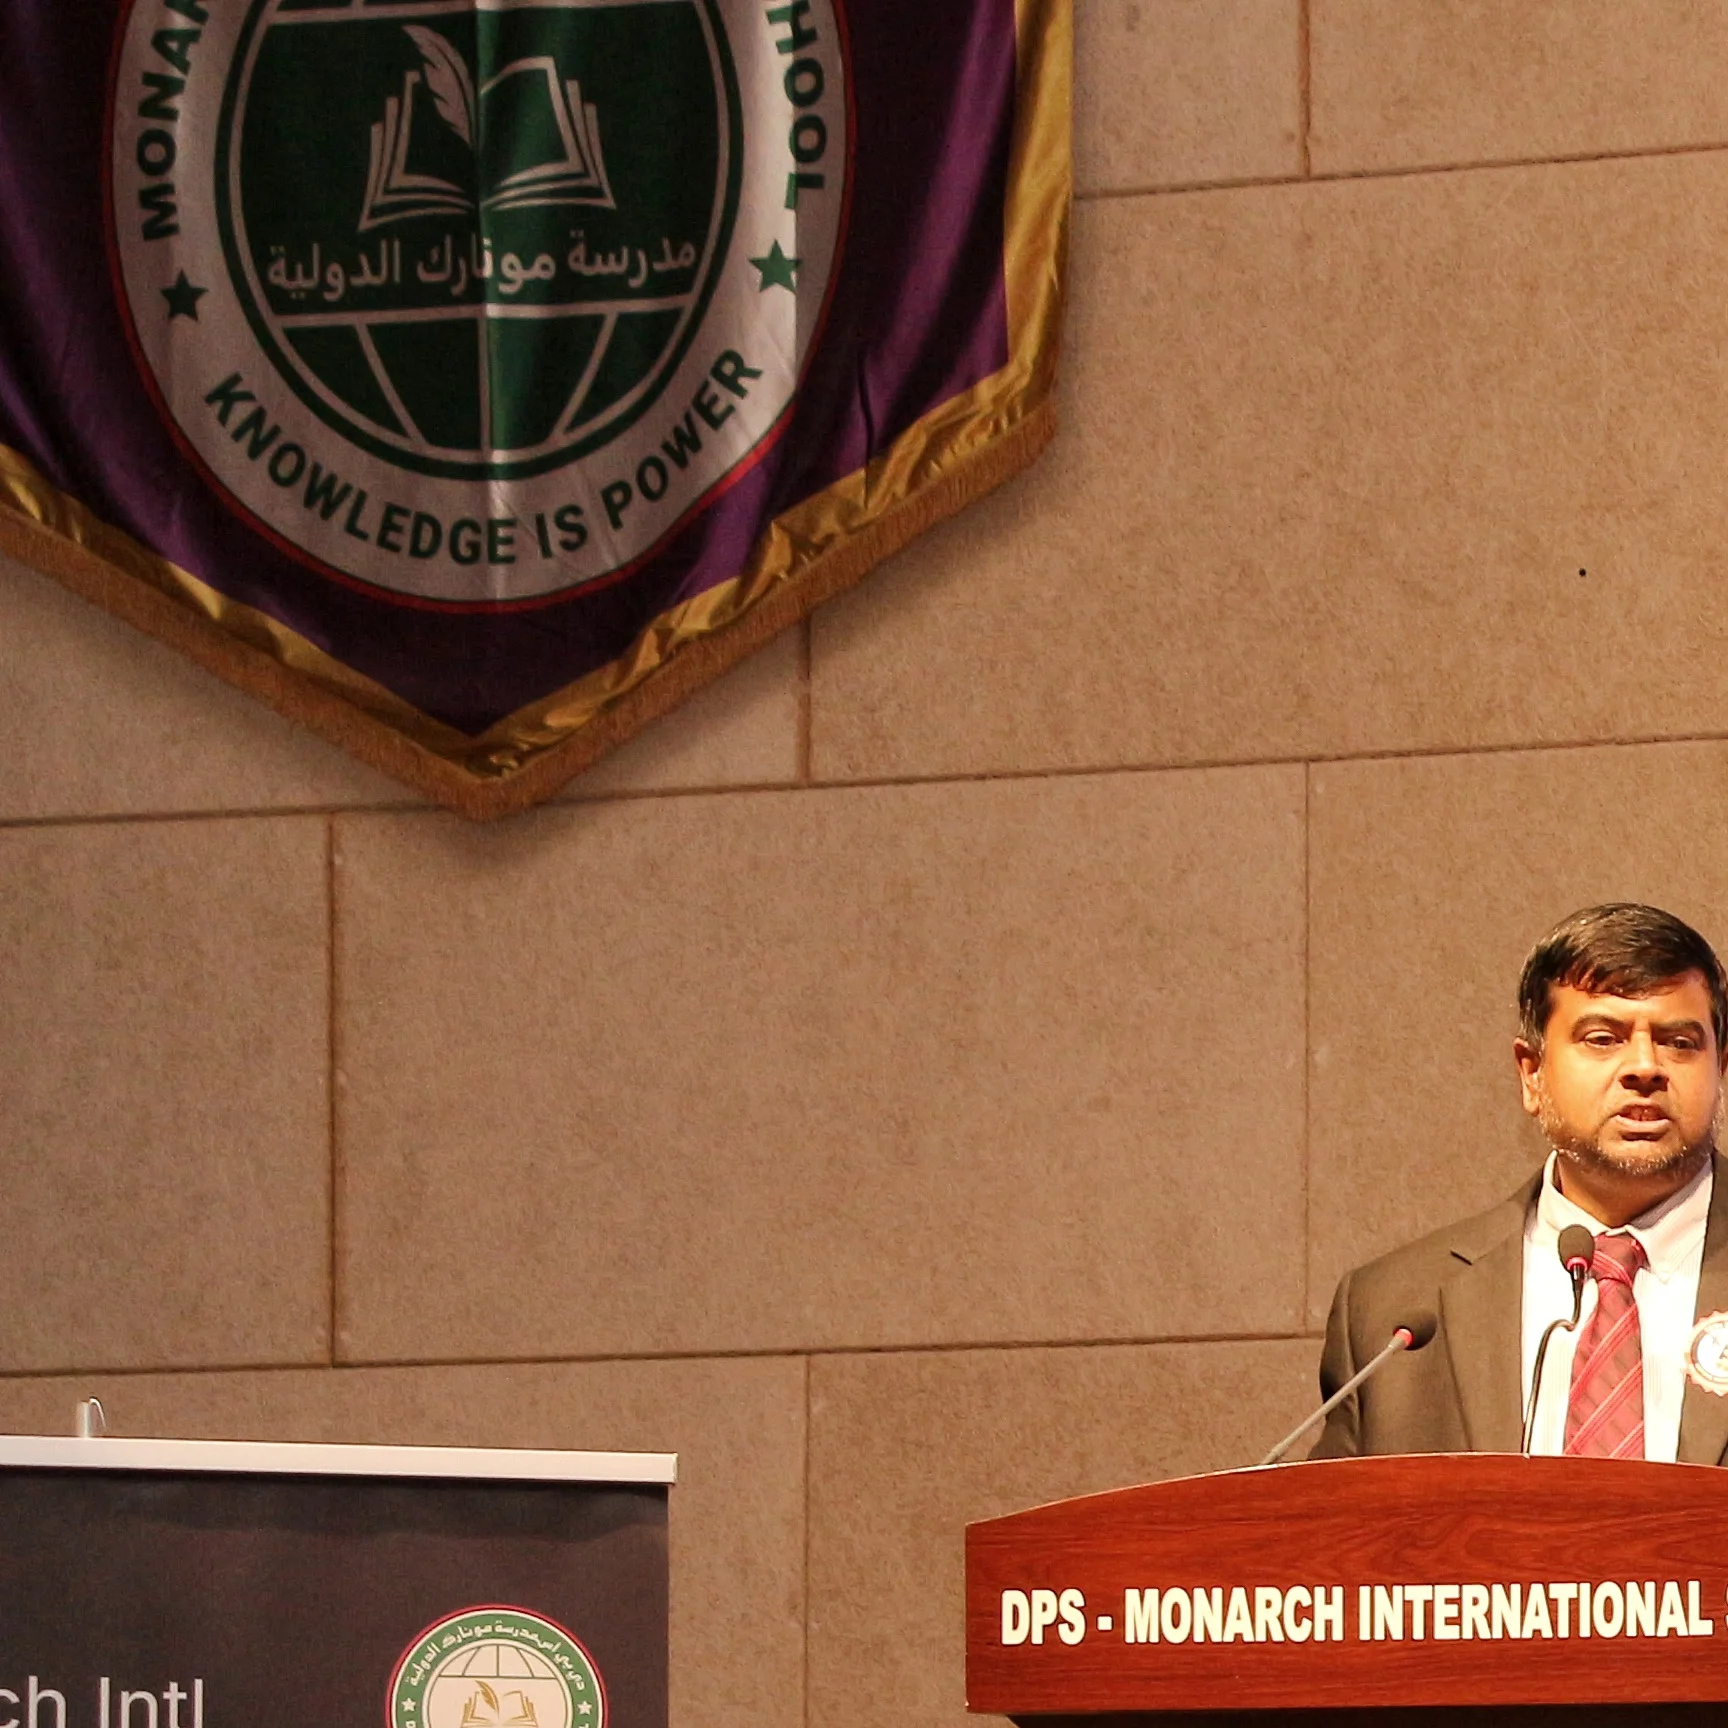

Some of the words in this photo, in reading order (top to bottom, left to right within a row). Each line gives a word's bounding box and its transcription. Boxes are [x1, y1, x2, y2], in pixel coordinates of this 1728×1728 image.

[268, 239, 399, 301] الدولية
[416, 233, 556, 295] مونارك
[568, 229, 696, 289] مدرسة
[203, 372, 517, 566] KNOWLEDGE
[535, 503, 588, 559] IS
[600, 348, 763, 532] POWER
[1001, 1588, 1086, 1645] DPS
[1123, 1585, 1343, 1645] MONARCH
[1358, 1581, 1713, 1640] INTERNATIONAL
